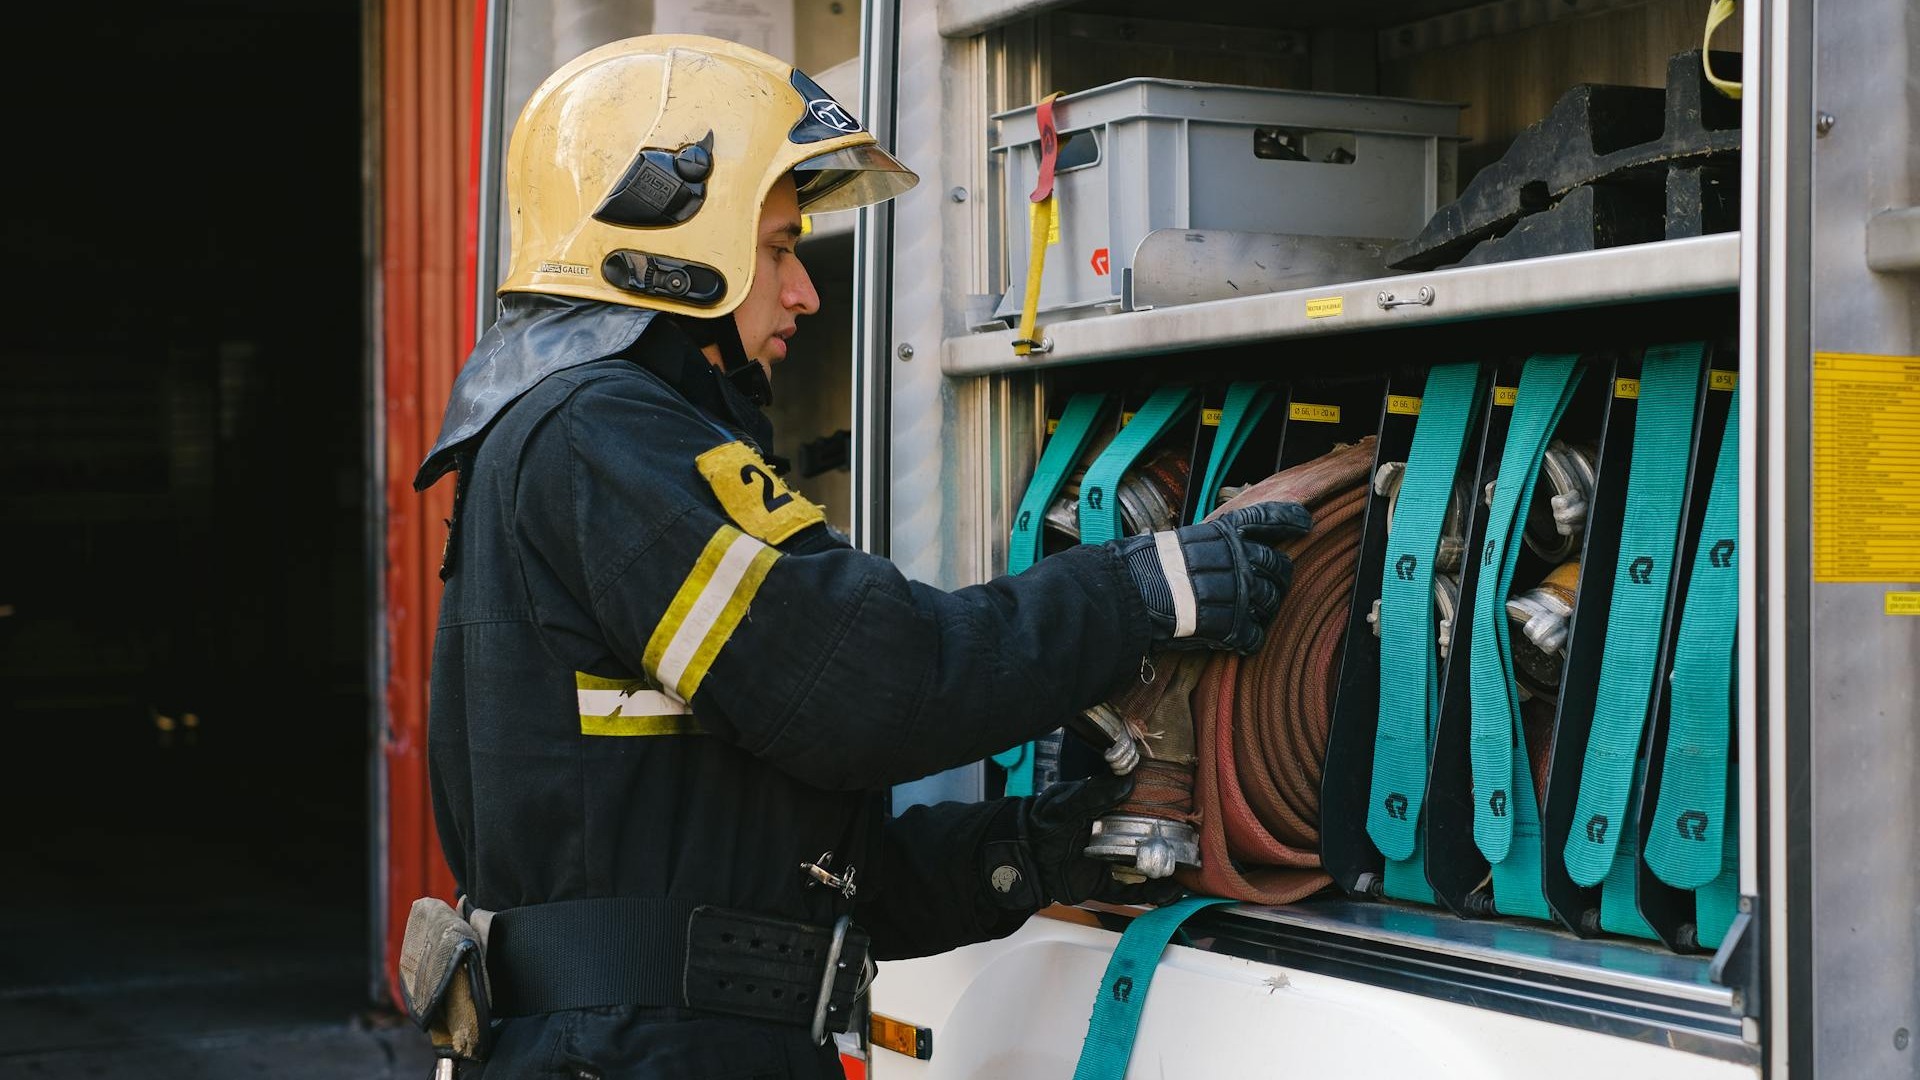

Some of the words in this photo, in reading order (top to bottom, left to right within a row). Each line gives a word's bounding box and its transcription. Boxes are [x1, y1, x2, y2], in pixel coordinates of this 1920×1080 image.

[817, 103, 853, 129] 27
[640, 171, 672, 197] MSA
[562, 266, 590, 275] GALLET
[740, 464, 795, 513] 2
